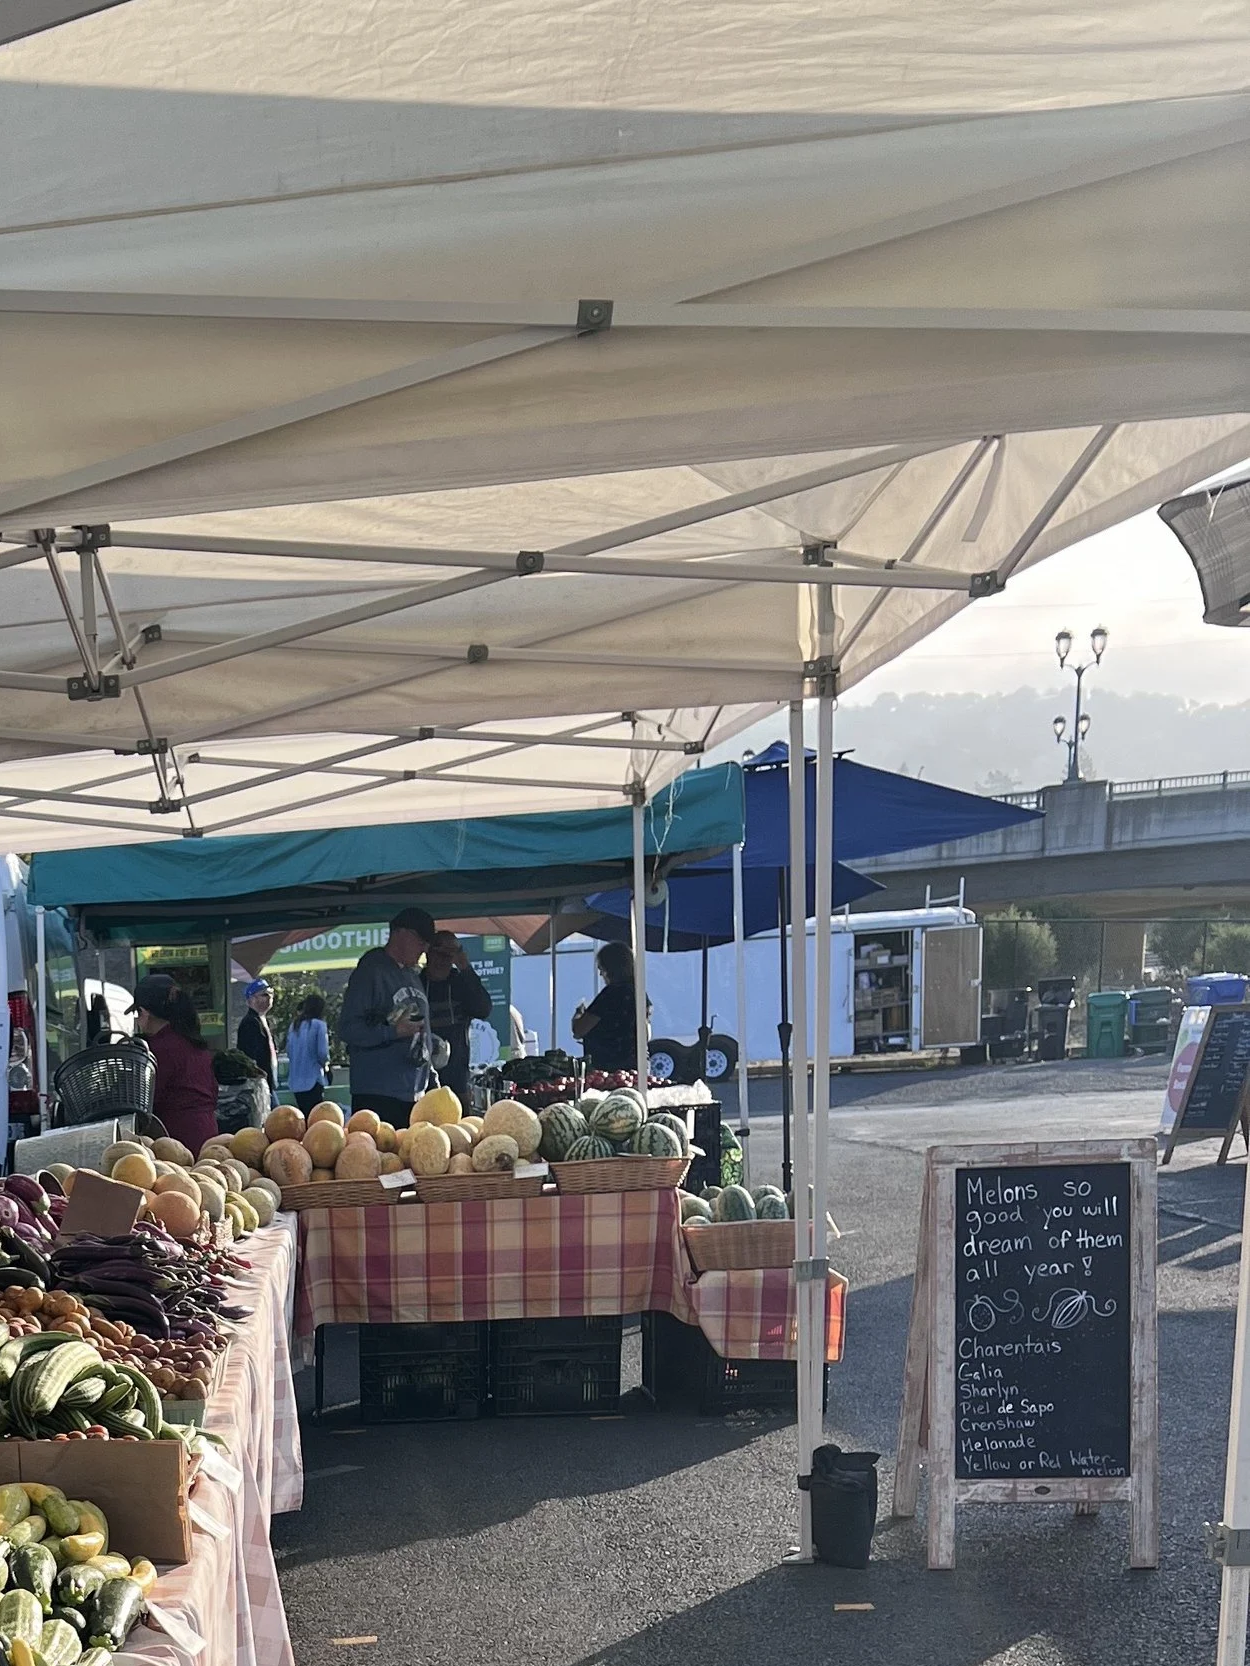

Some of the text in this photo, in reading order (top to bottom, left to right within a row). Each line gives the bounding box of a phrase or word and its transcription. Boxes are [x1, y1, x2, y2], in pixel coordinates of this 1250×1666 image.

[967, 1176, 1091, 1205] Melons so
[966, 1196, 1118, 1235] good you will
[963, 1228, 1123, 1257] dream of them
[966, 1260, 998, 1282] all
[958, 1334, 1062, 1359] Charentais
[958, 1362, 1003, 1381] Galia
[960, 1381, 1019, 1400] Sharlyn
[960, 1399, 1055, 1417] Piel de Sapo
[960, 1417, 1036, 1432] Crenshaw
[961, 1434, 1036, 1453] Melonade
[963, 1454, 1010, 1473] Yellow
[1019, 1460, 1035, 1470] or
[1039, 1451, 1062, 1470] Red
[1081, 1465, 1126, 1478] melon
